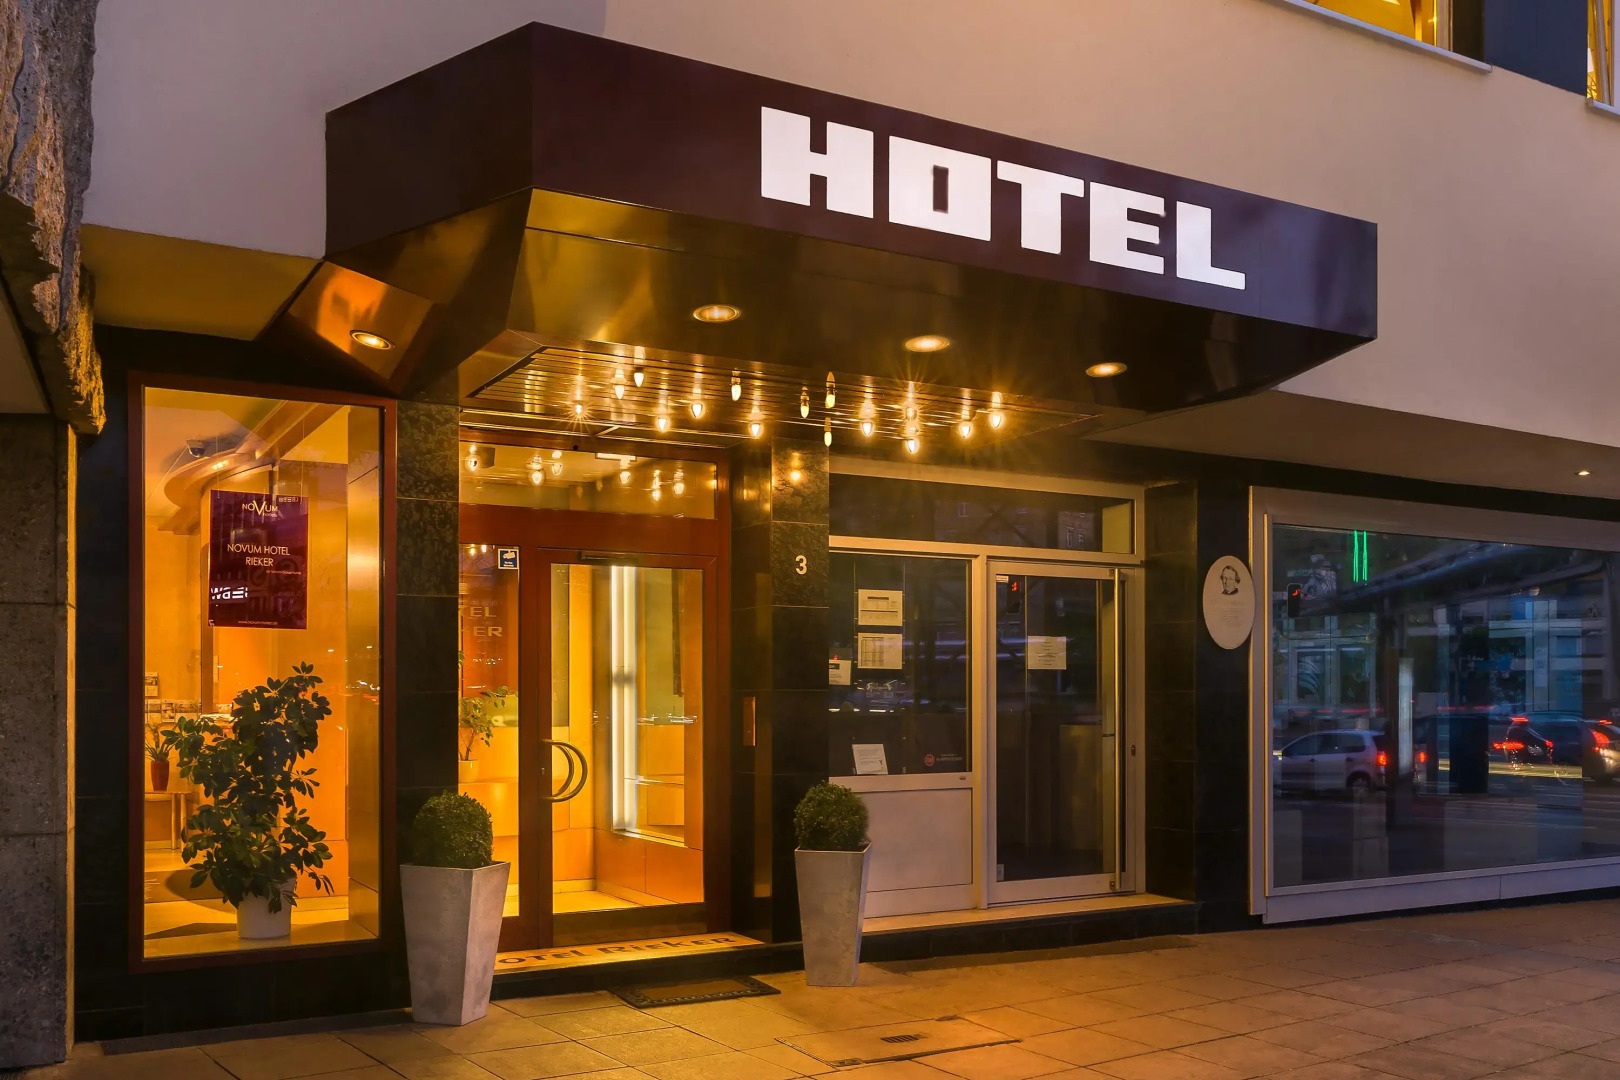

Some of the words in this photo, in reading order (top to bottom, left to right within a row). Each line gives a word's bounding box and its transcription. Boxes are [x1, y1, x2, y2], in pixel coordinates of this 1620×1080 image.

[761, 106, 1246, 290] HOTEL
[227, 543, 262, 554] NOVUM
[263, 546, 290, 556] HOTEL
[245, 557, 274, 567] RIEKER
[795, 554, 808, 575] 3
[497, 949, 587, 964] OTEL
